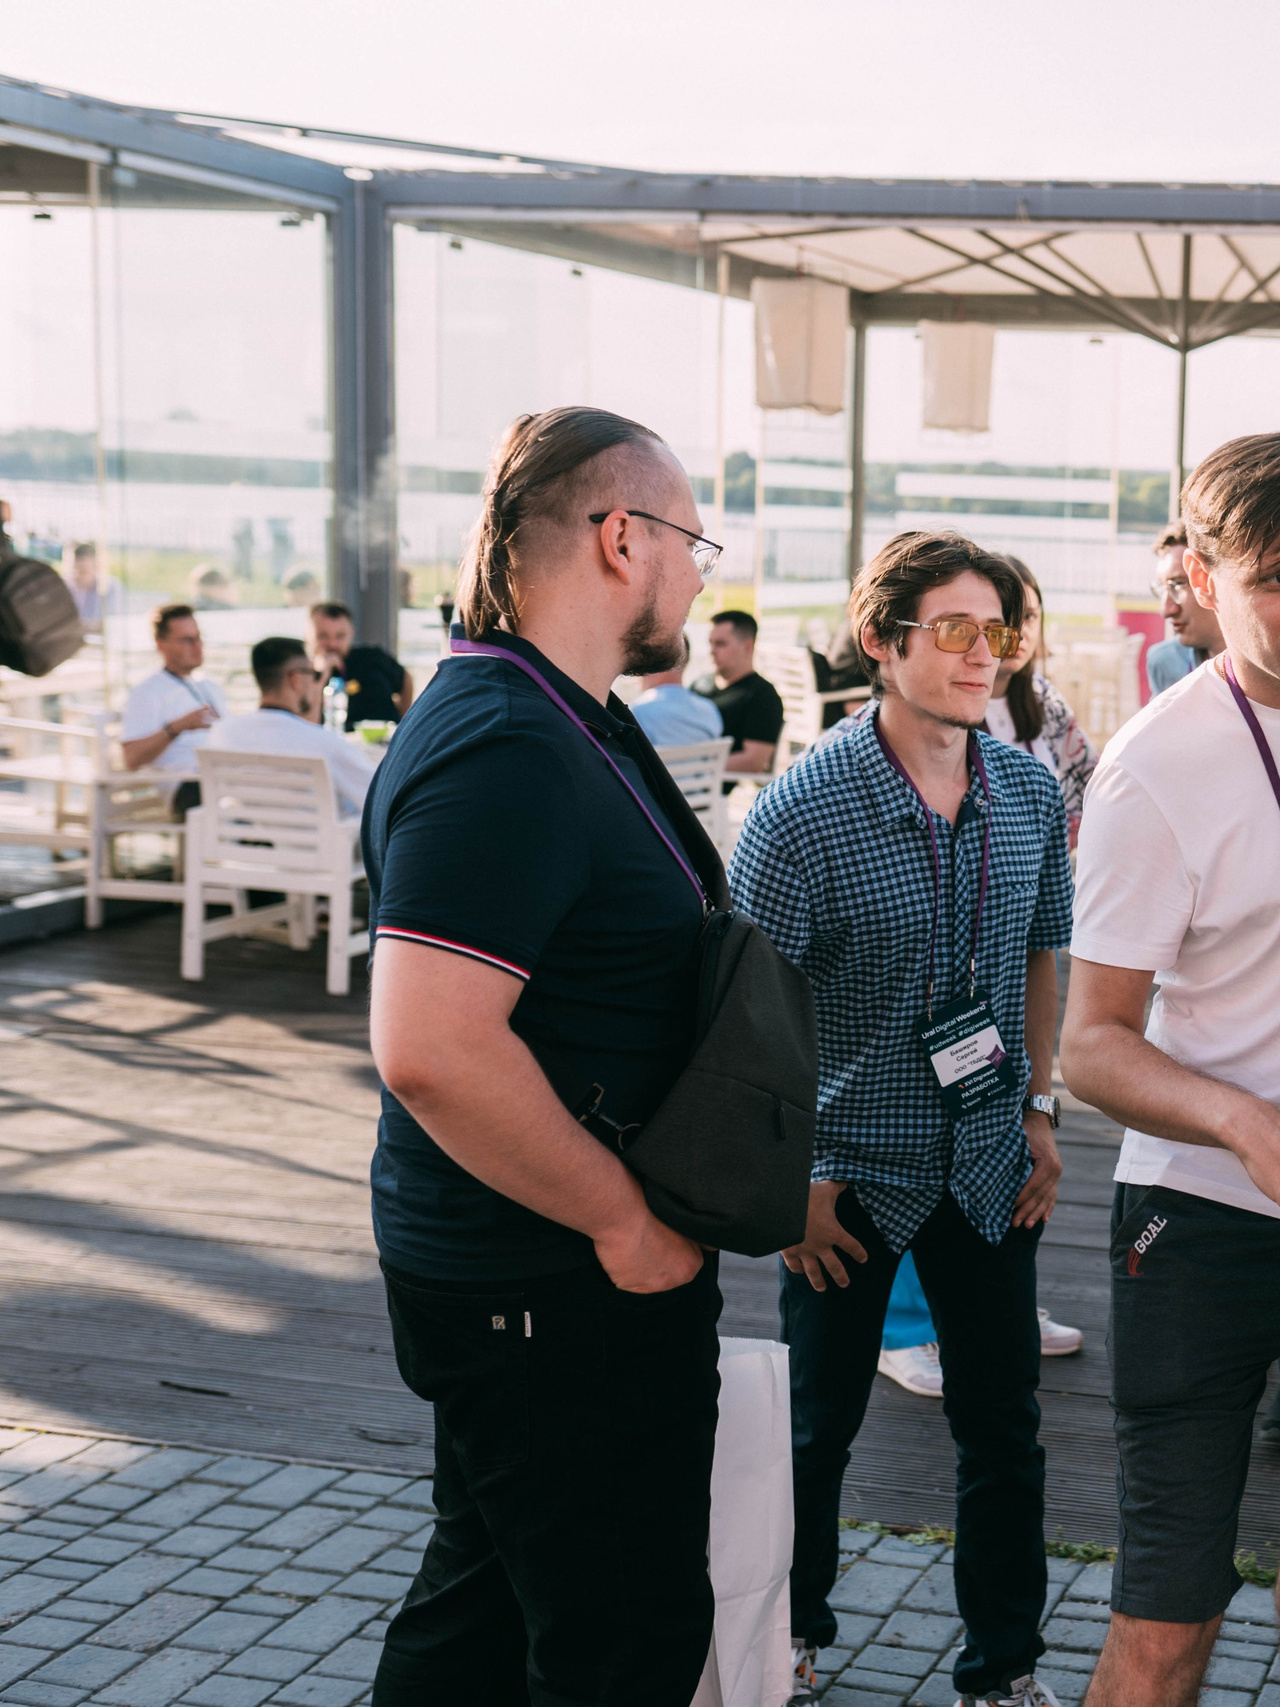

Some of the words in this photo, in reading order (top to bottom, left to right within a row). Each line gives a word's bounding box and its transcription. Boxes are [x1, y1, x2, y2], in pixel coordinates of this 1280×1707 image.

[921, 1029, 935, 1040] Ural
[935, 1018, 957, 1033] Digital
[955, 1004, 986, 1023] Weekend
[1134, 1215, 1168, 1254] GOAL
